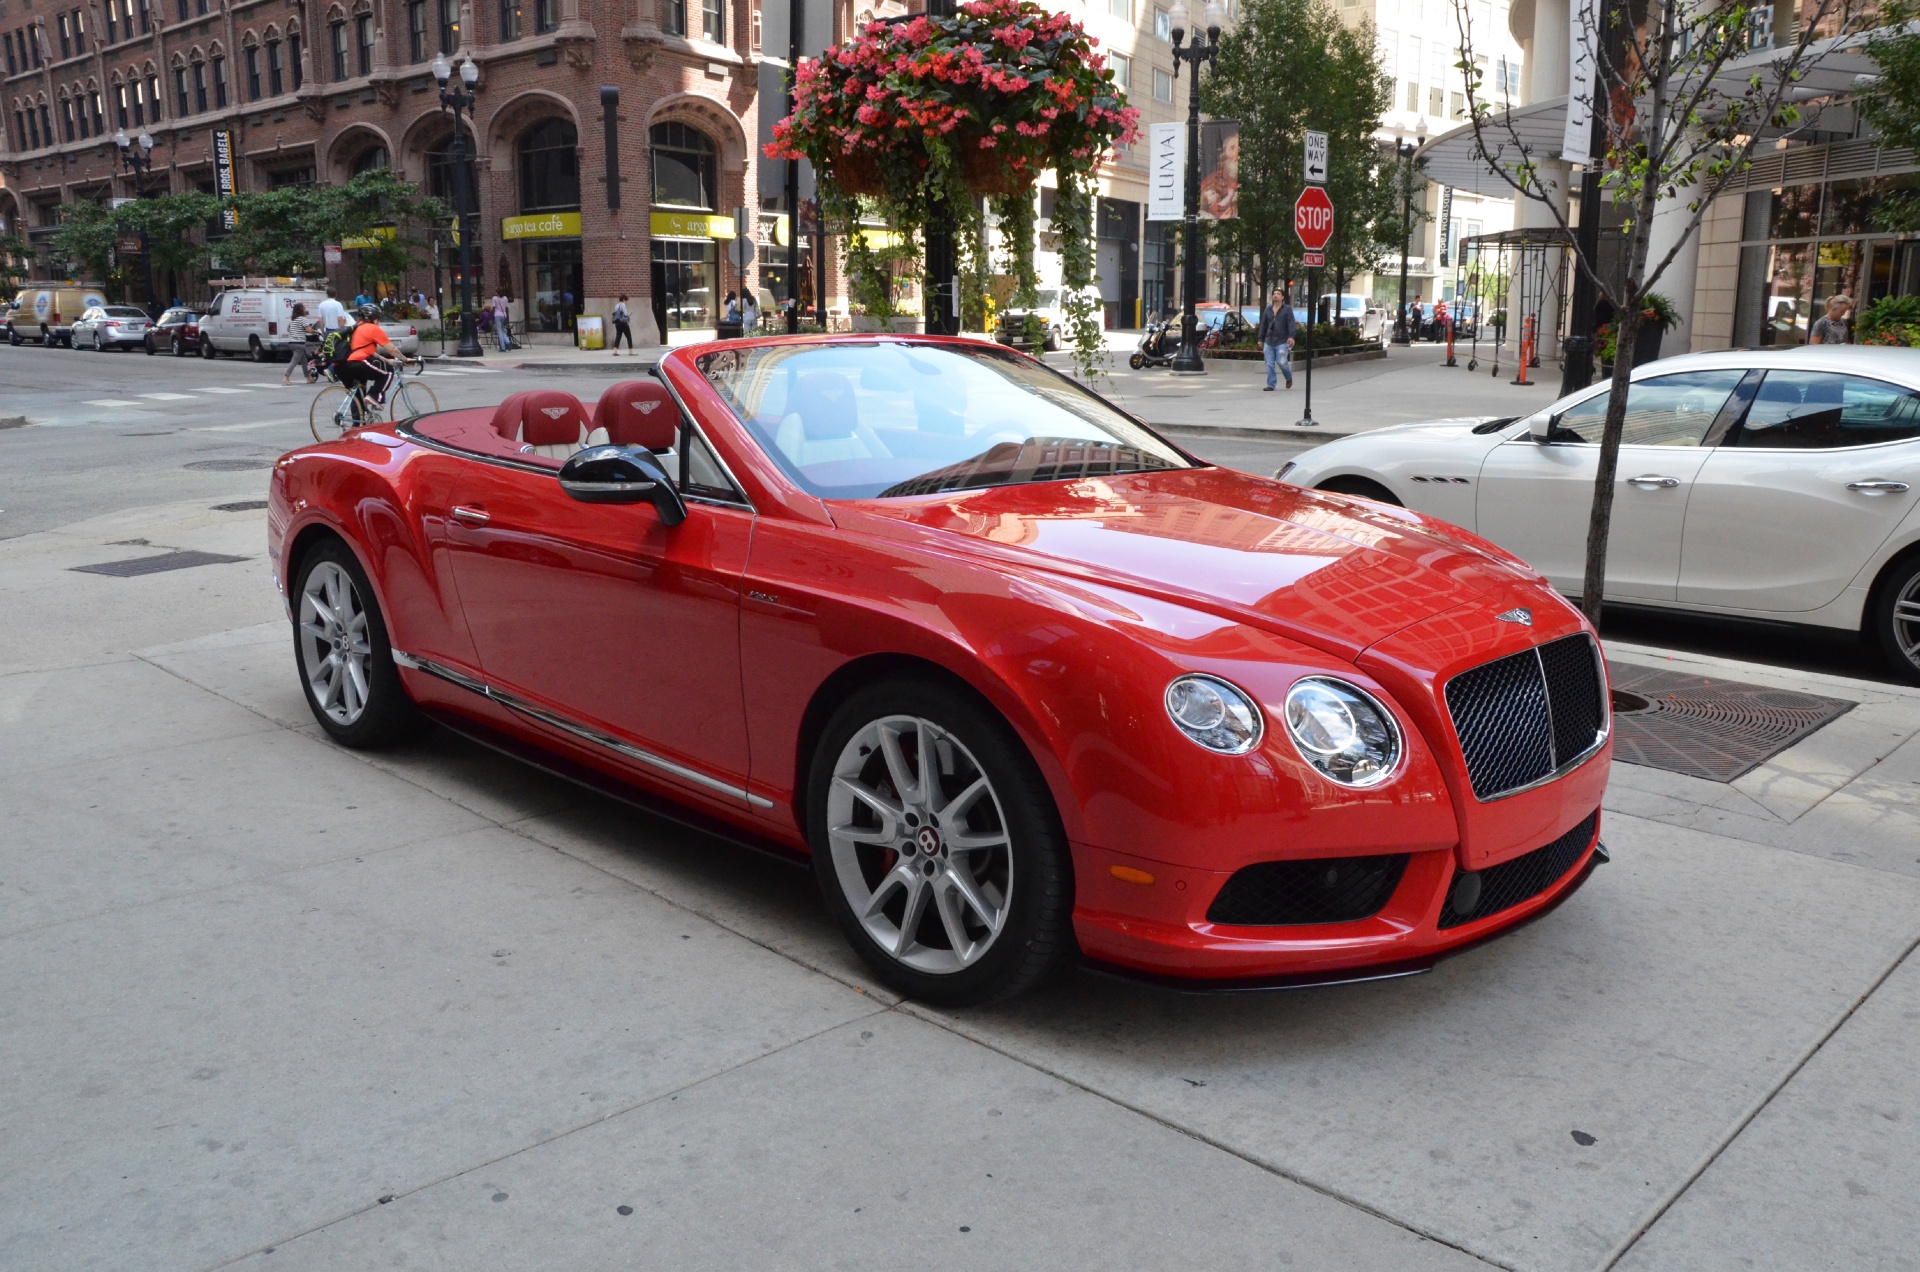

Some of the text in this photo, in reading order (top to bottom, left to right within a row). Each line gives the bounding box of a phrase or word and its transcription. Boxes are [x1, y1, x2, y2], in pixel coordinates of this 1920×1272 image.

[217, 131, 230, 165] BAGELS
[1308, 135, 1325, 149] ONE
[1307, 149, 1325, 162] WAY
[1158, 135, 1176, 201] LUMA
[524, 220, 537, 233] tea
[538, 214, 564, 232] café
[686, 220, 709, 235] argo
[1297, 205, 1331, 231] STOP
[1439, 186, 1451, 255] ORDSTROM rack
[1305, 256, 1322, 265] ALL WAY
